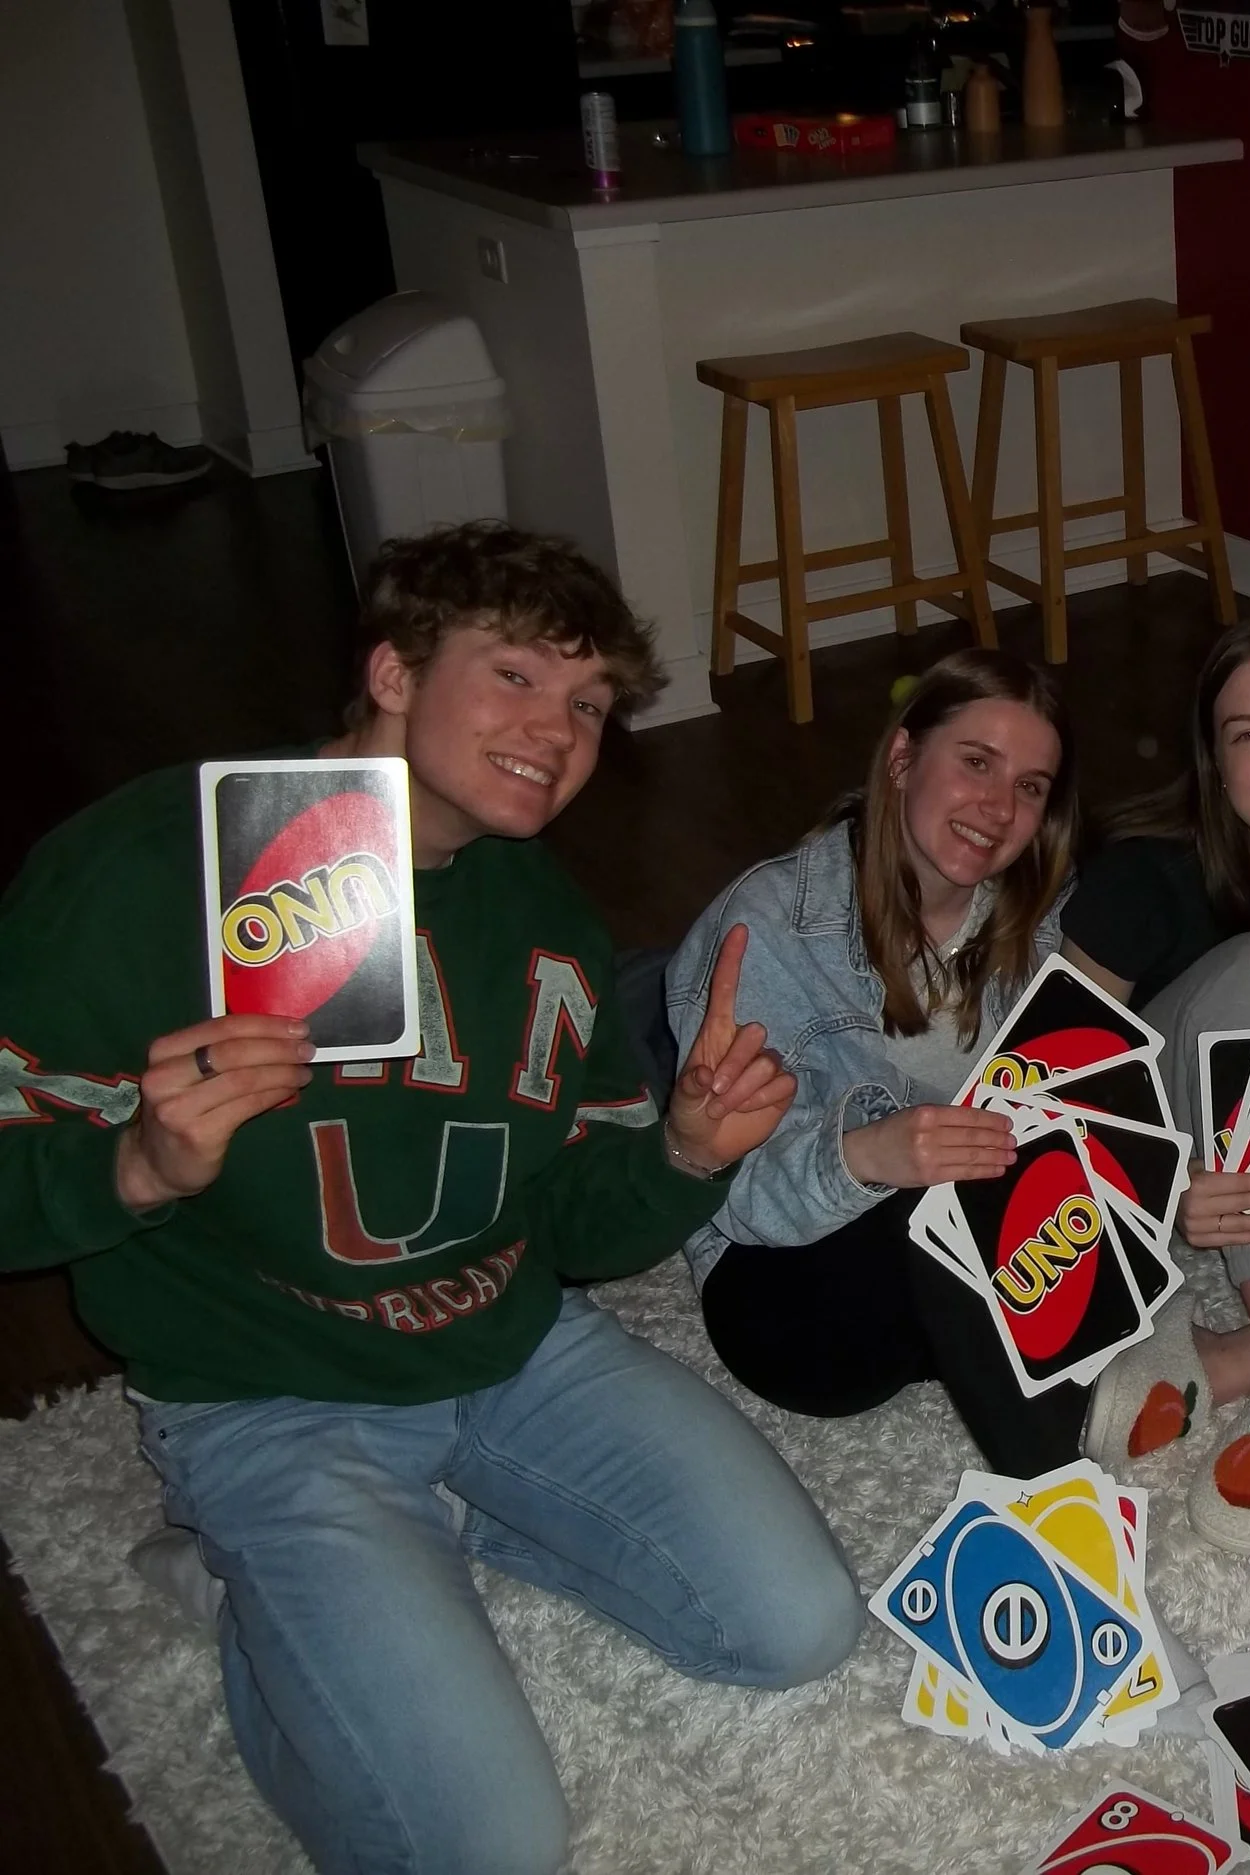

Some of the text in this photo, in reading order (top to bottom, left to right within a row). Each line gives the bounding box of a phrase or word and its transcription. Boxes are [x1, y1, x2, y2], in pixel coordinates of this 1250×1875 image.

[1197, 15, 1226, 44] TOP
[221, 852, 400, 968] UNO
[990, 1194, 1105, 1315] UNO
[1098, 1800, 1140, 1831] 8
